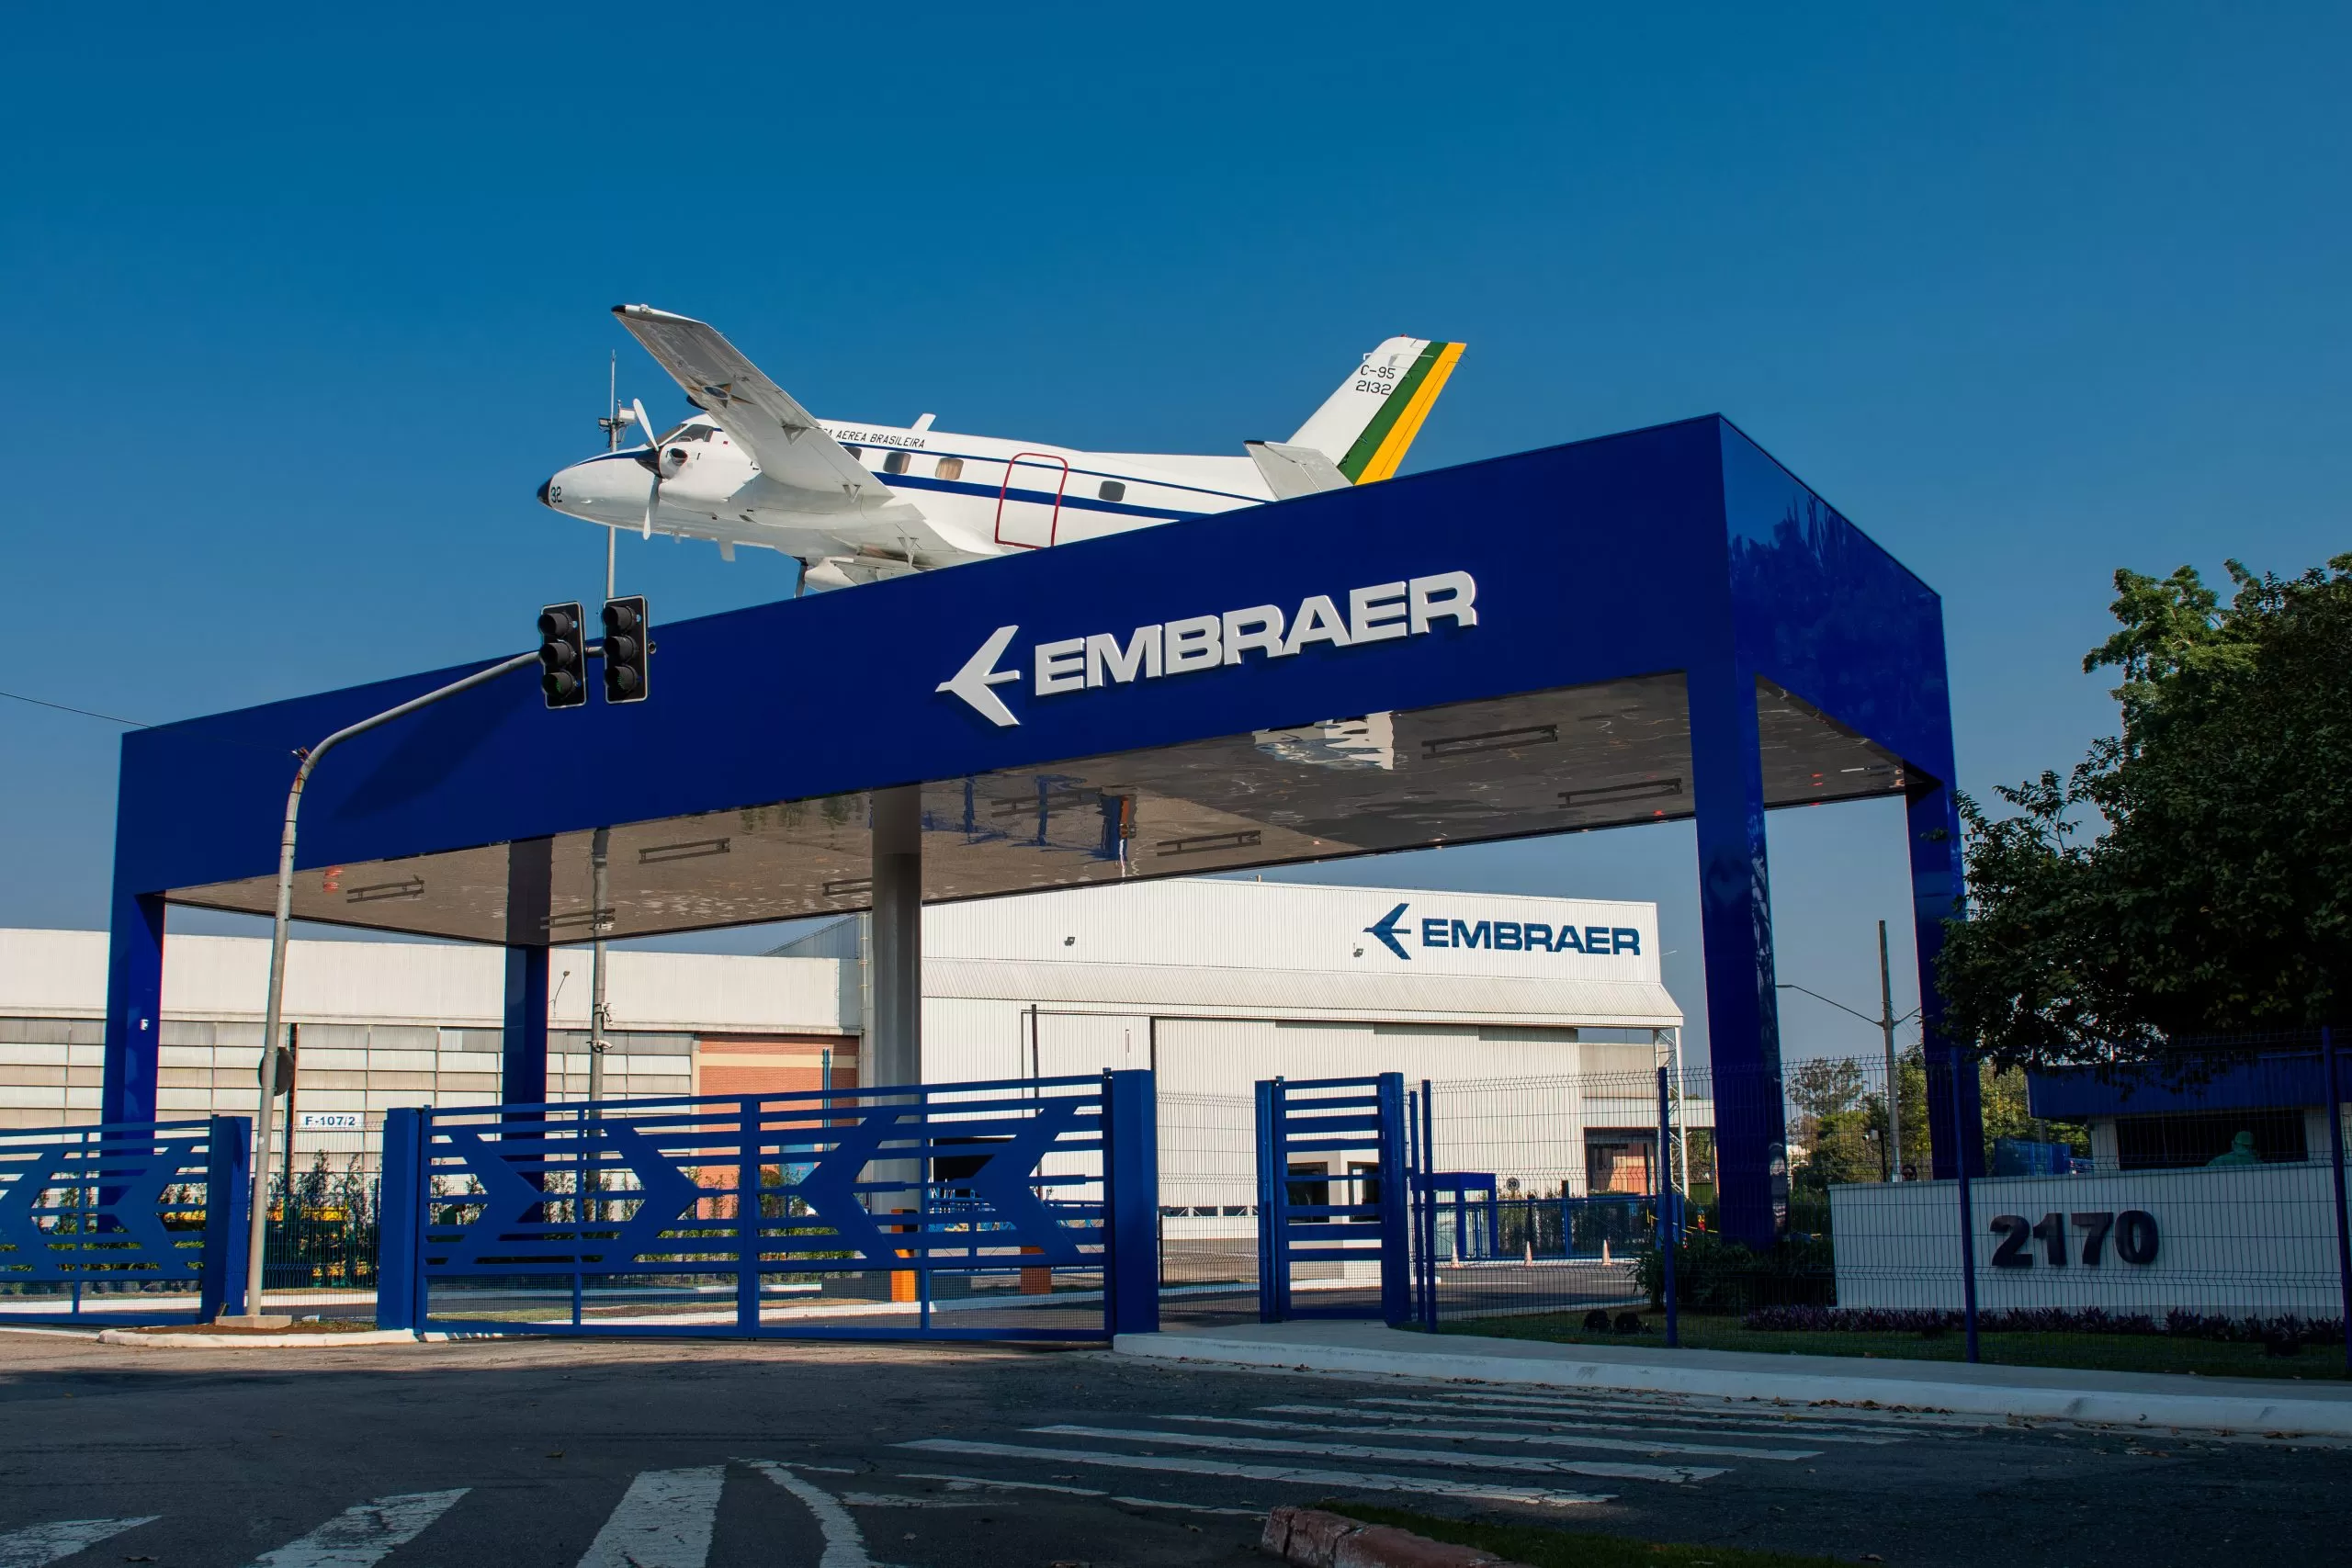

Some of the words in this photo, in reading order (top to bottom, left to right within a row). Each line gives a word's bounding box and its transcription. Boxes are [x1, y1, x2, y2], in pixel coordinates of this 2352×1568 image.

[1360, 365, 1396, 379] C-95
[1355, 380, 1392, 396] 2132
[836, 430, 866, 442] AEREA
[870, 433, 925, 448] BRASILEIRA
[550, 486, 562, 502] 32
[1035, 570, 1477, 695] EMBRAER
[1422, 918, 1641, 955] EMBRAER
[305, 1116, 356, 1126] F-107/2
[1990, 1210, 2159, 1267] 2170
